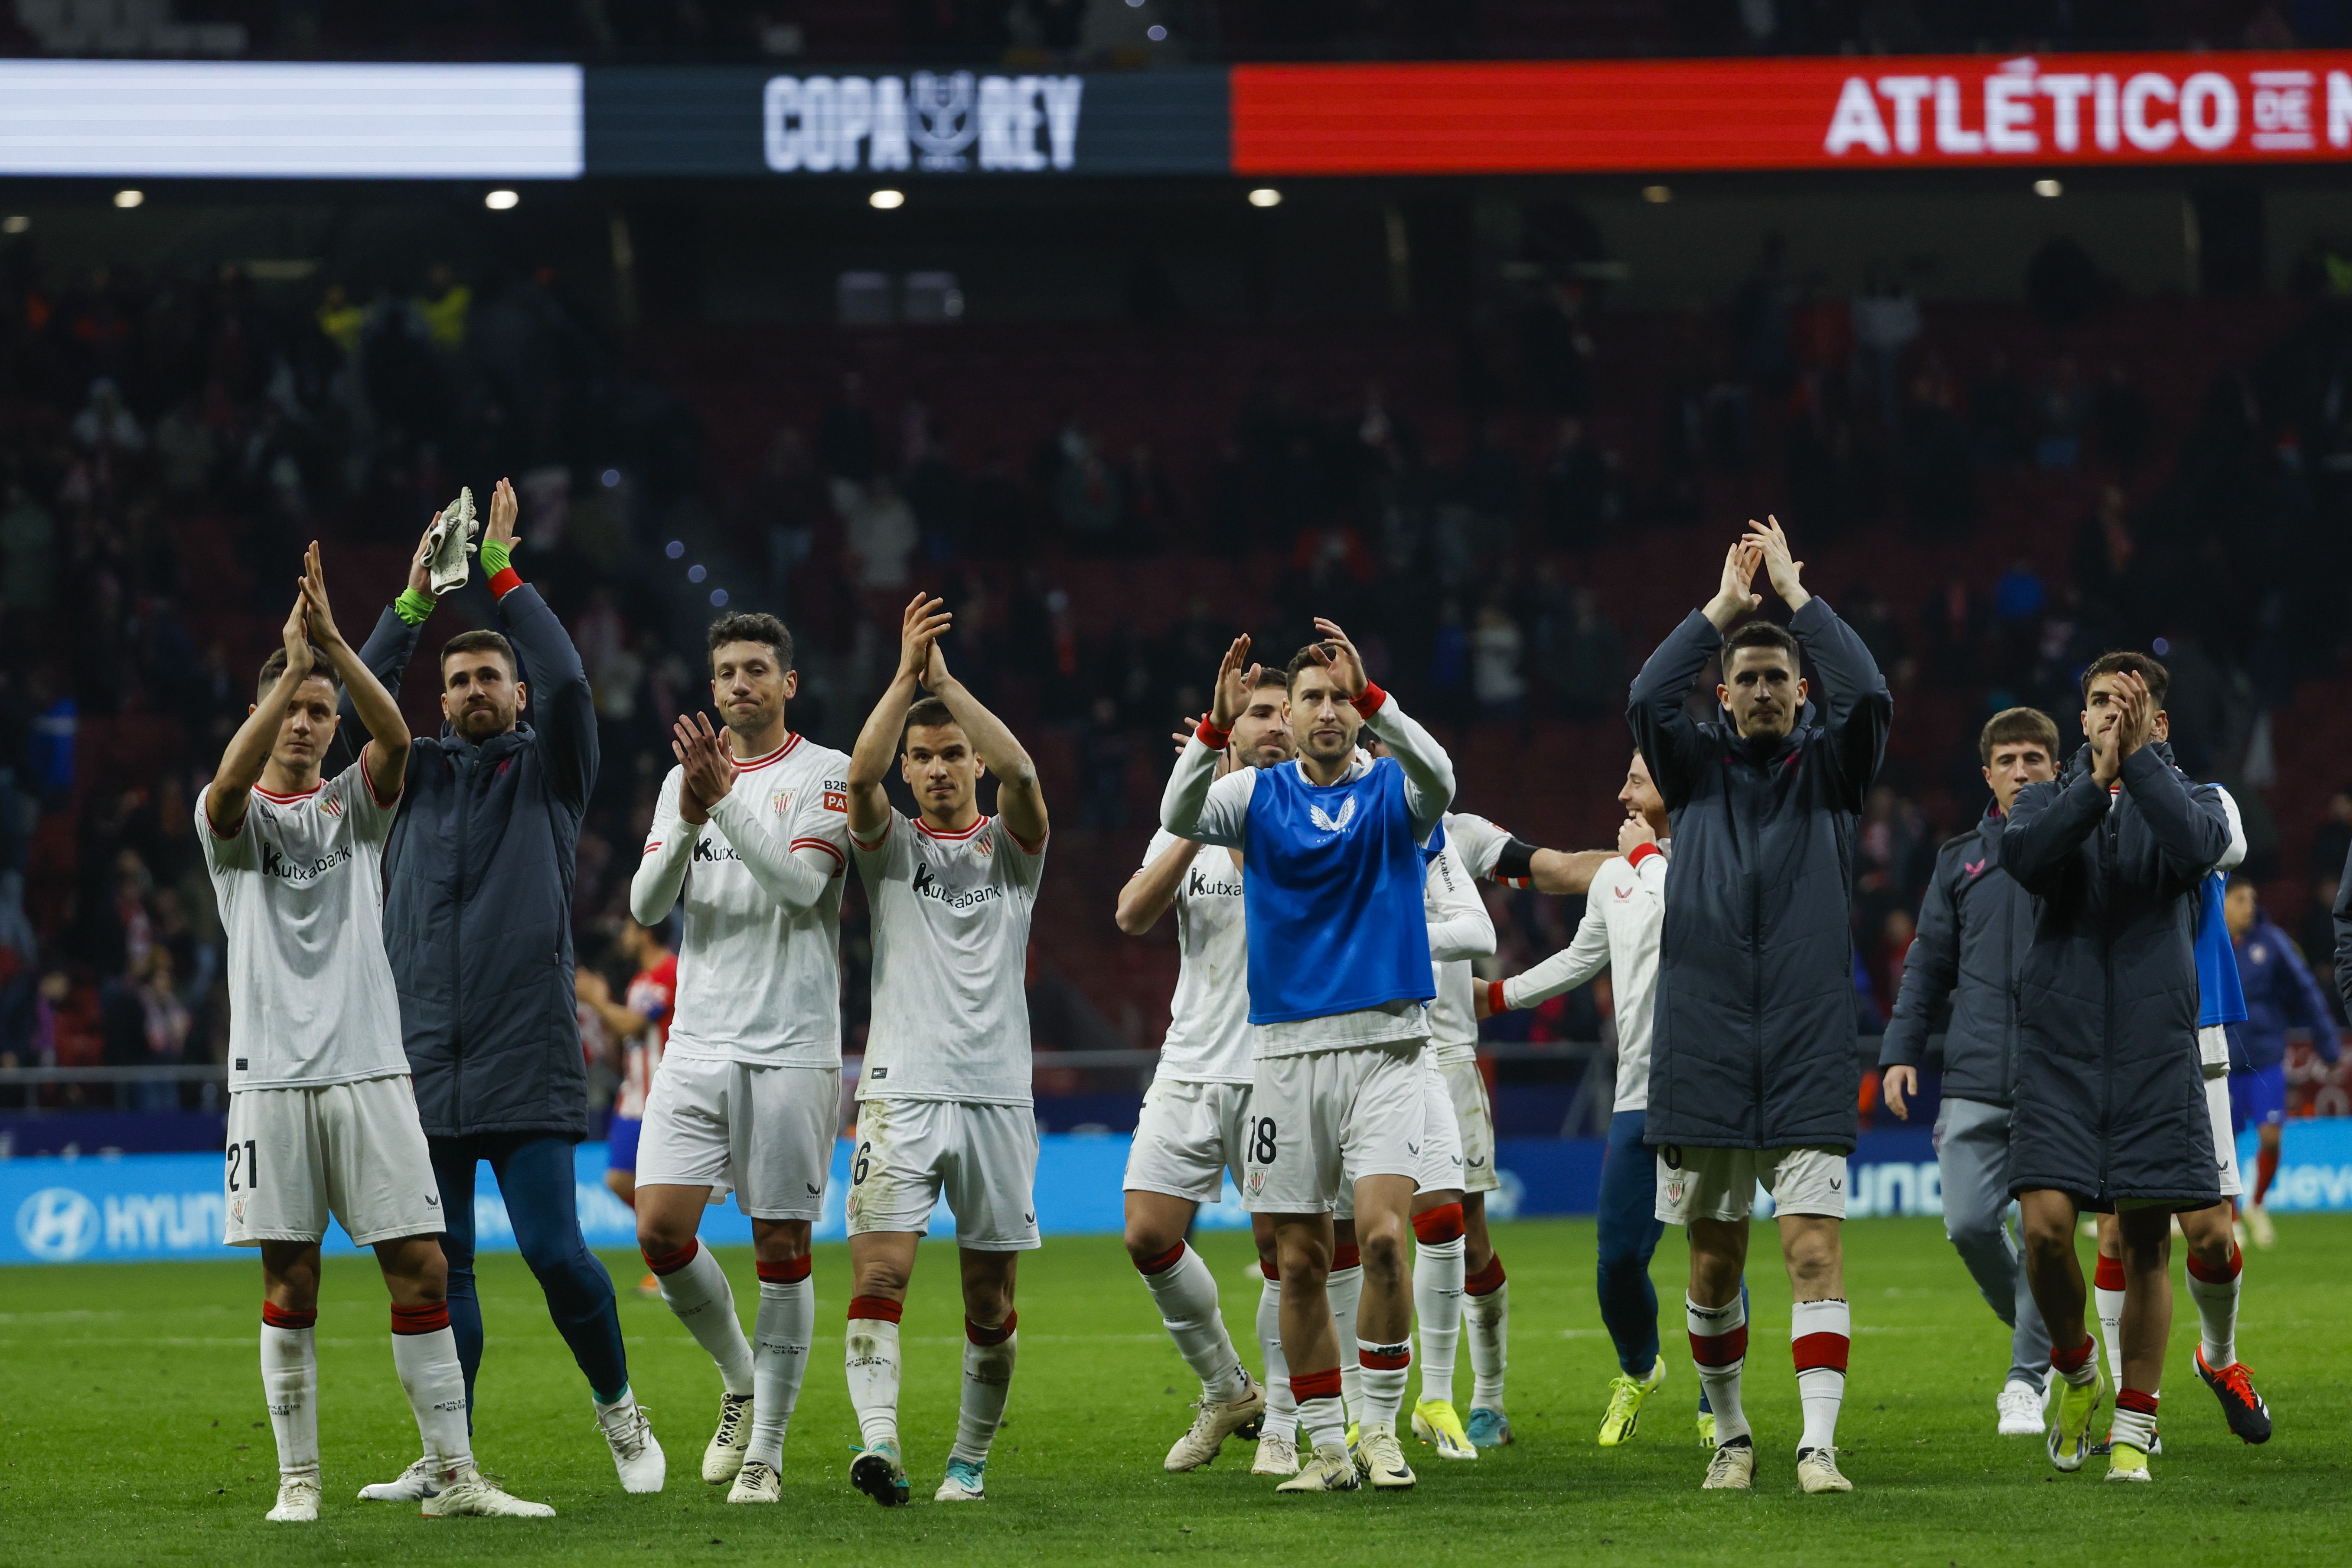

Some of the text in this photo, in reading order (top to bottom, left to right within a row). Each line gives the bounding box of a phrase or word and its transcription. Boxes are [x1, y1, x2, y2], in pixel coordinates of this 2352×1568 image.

[763, 75, 1084, 172] COPA REY
[1824, 55, 2240, 155] ATLÉTICO
[2254, 88, 2311, 133] DE
[828, 795, 848, 809] PA
[263, 842, 352, 880] Kutxabank
[913, 862, 1001, 909] Kutxabank
[854, 1141, 871, 1186] 6
[1247, 1115, 1276, 1164] 18
[227, 1140, 257, 1193] 21
